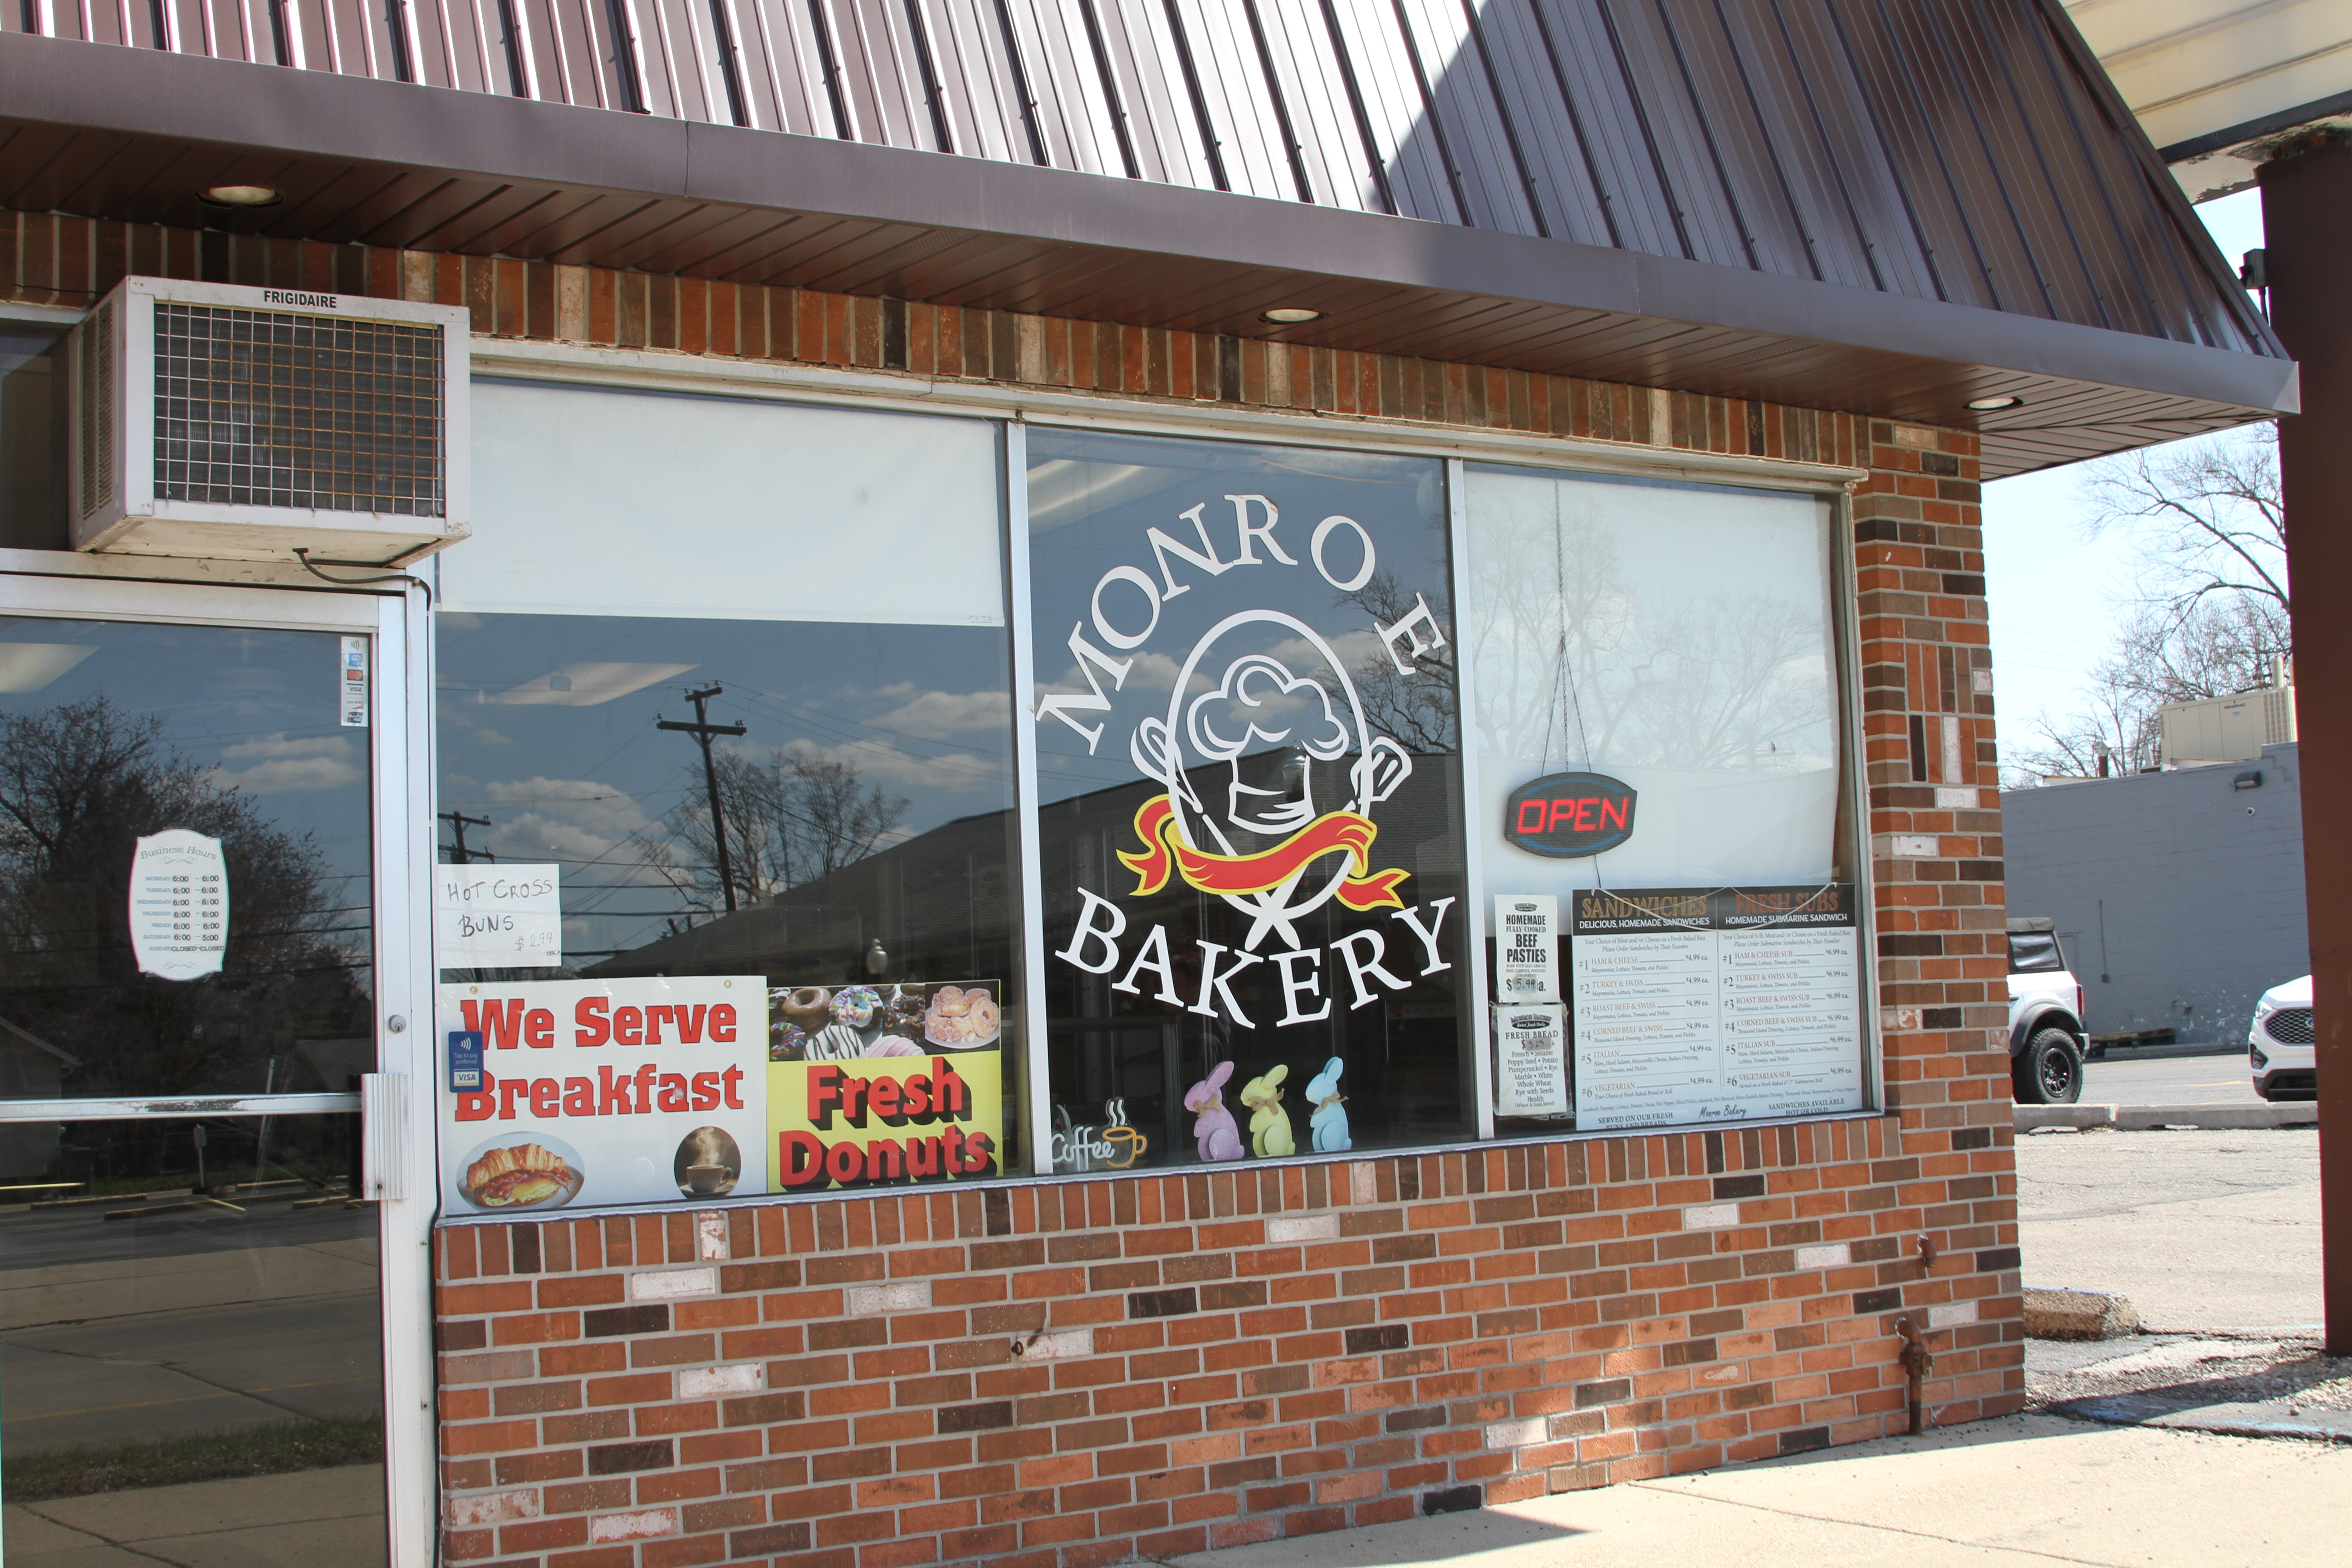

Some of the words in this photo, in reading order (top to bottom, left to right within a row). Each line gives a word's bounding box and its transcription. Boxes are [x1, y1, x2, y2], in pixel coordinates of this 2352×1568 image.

[264, 290, 337, 309] FRIGIDAIRE
[1035, 494, 1446, 755] MONROE
[1517, 797, 1629, 833] OPEN
[141, 846, 184, 859] Business
[186, 846, 217, 860] Hours
[448, 881, 487, 902] HOT
[494, 879, 552, 899] CROSS
[1582, 896, 1708, 918] SANDWICHES
[1735, 893, 1791, 914] FRESH
[1795, 892, 1839, 912] SUBS
[458, 914, 514, 937] BUNS
[1506, 914, 1546, 925] HOMEMADE
[1579, 919, 1618, 929] DELICIOUS,
[1619, 918, 1661, 928] HOMEMADE
[1663, 917, 1710, 926] SANDWICHES
[1725, 915, 1767, 925] HOMEMADE
[1768, 914, 1808, 923] SUBMARINE
[1810, 913, 1847, 921] SANDWICH
[1515, 934, 1538, 947] BEEF
[546, 948, 560, 956] each
[1055, 887, 1455, 1029] BAKERY
[1506, 949, 1546, 963] PASTIES
[1723, 954, 1732, 964] #1
[1579, 960, 1588, 970] #1
[1536, 980, 1546, 991] a.
[1579, 983, 1590, 994] #2
[1723, 976, 1734, 987] #2
[1724, 999, 1734, 1010] #3
[1580, 1007, 1590, 1018] #3
[460, 998, 555, 1050] We
[575, 996, 737, 1047] Serve
[1725, 1022, 1735, 1032] #4
[1505, 1031, 1529, 1039] FRESH
[1533, 1030, 1558, 1039] BREAD
[1581, 1030, 1591, 1041] #4
[1593, 1027, 1621, 1035] CORNED
[1725, 1044, 1735, 1055] #5
[1581, 1054, 1592, 1065] #5
[1593, 1050, 1620, 1058] ITALIAN
[1508, 1065, 1543, 1073] Pumpernickel
[1727, 1075, 1737, 1087] #6
[1739, 1072, 1778, 1081] VEGETARIAN
[454, 1063, 744, 1122] Breakfast
[807, 1056, 971, 1129] Fresh
[1582, 1086, 1592, 1098] #6
[1594, 1083, 1635, 1092] VEGETARIAN
[1768, 1101, 1809, 1110] SANDWICHES
[1810, 1098, 1844, 1107] AVAILABLE
[1699, 1105, 1720, 1119] Monroe
[1724, 1104, 1747, 1119] Bakery
[1052, 1126, 1115, 1171] Coffee
[779, 1124, 994, 1188] Donuts
